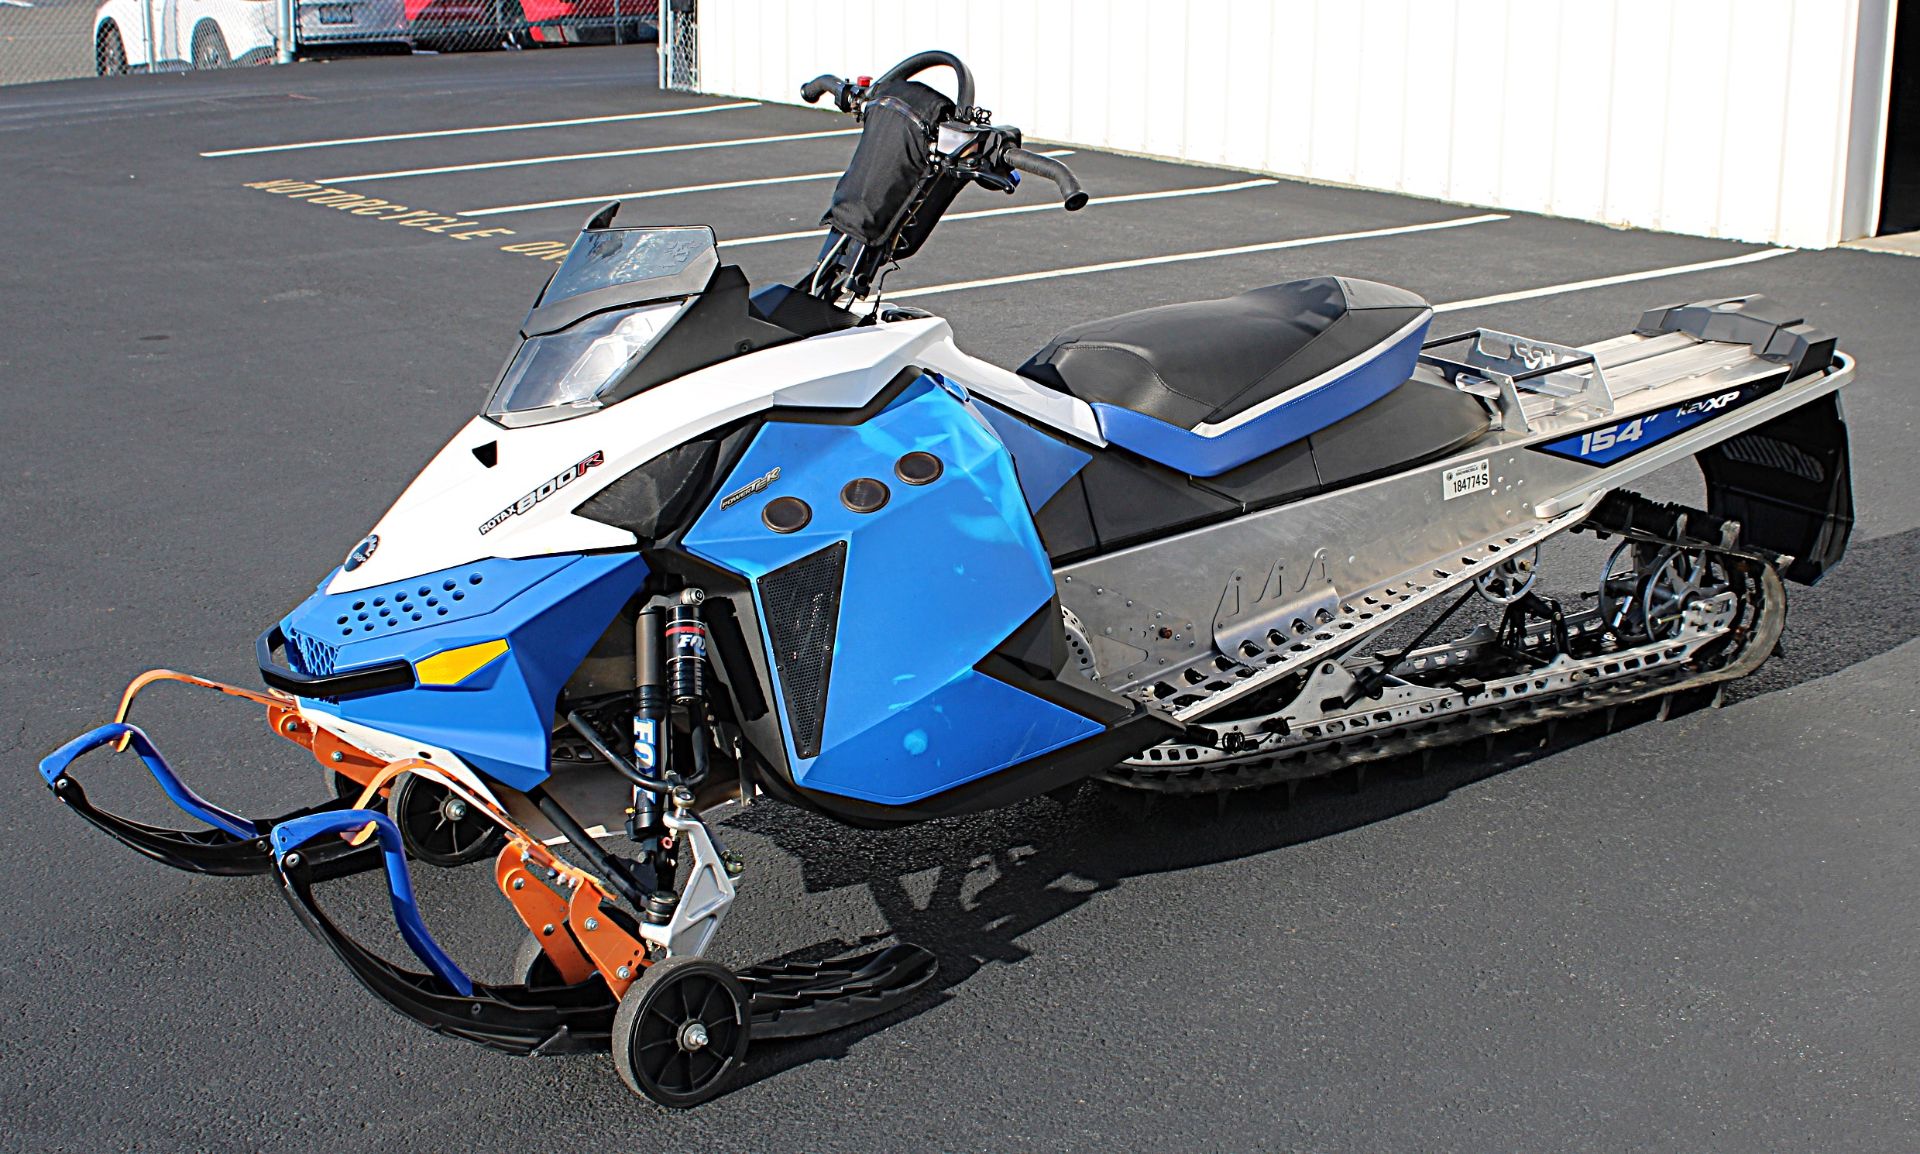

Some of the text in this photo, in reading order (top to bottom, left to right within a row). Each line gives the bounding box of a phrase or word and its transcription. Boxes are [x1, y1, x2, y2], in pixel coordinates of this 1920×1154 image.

[242, 178, 572, 265] MOTORCYCLE ON
[481, 450, 604, 535] ROTAX 800R
[1453, 473, 1489, 494] 184774S
